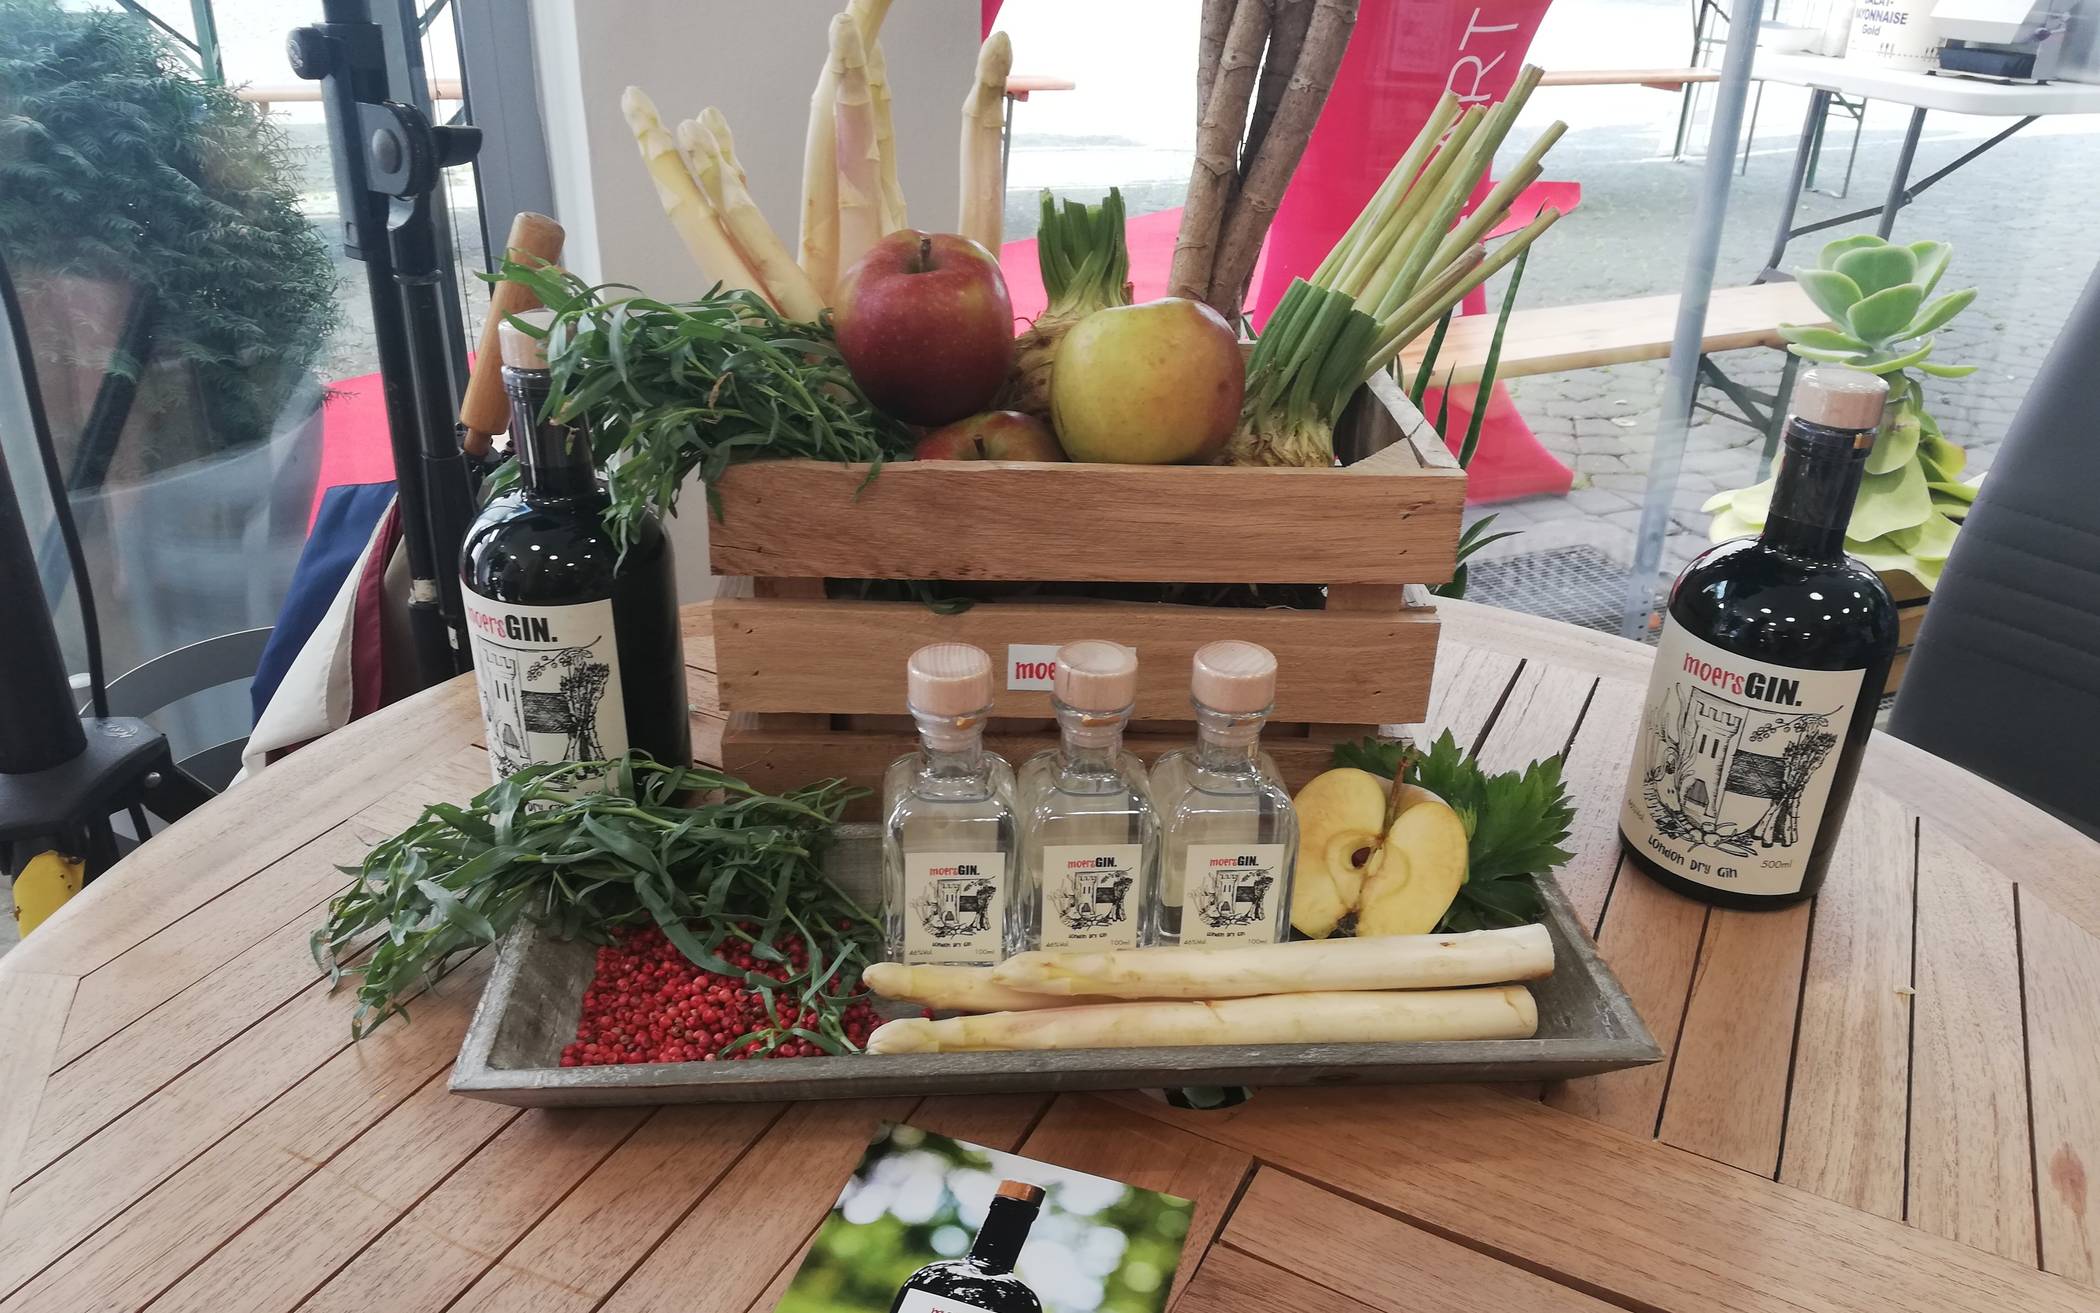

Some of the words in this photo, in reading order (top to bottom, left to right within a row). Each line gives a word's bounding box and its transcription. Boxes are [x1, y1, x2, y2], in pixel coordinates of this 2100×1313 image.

[1446, 7, 1520, 103] RT
[1015, 662, 1056, 680] moe
[1682, 652, 1802, 707] moersGIN.
[1760, 859, 1793, 869] 500ml
